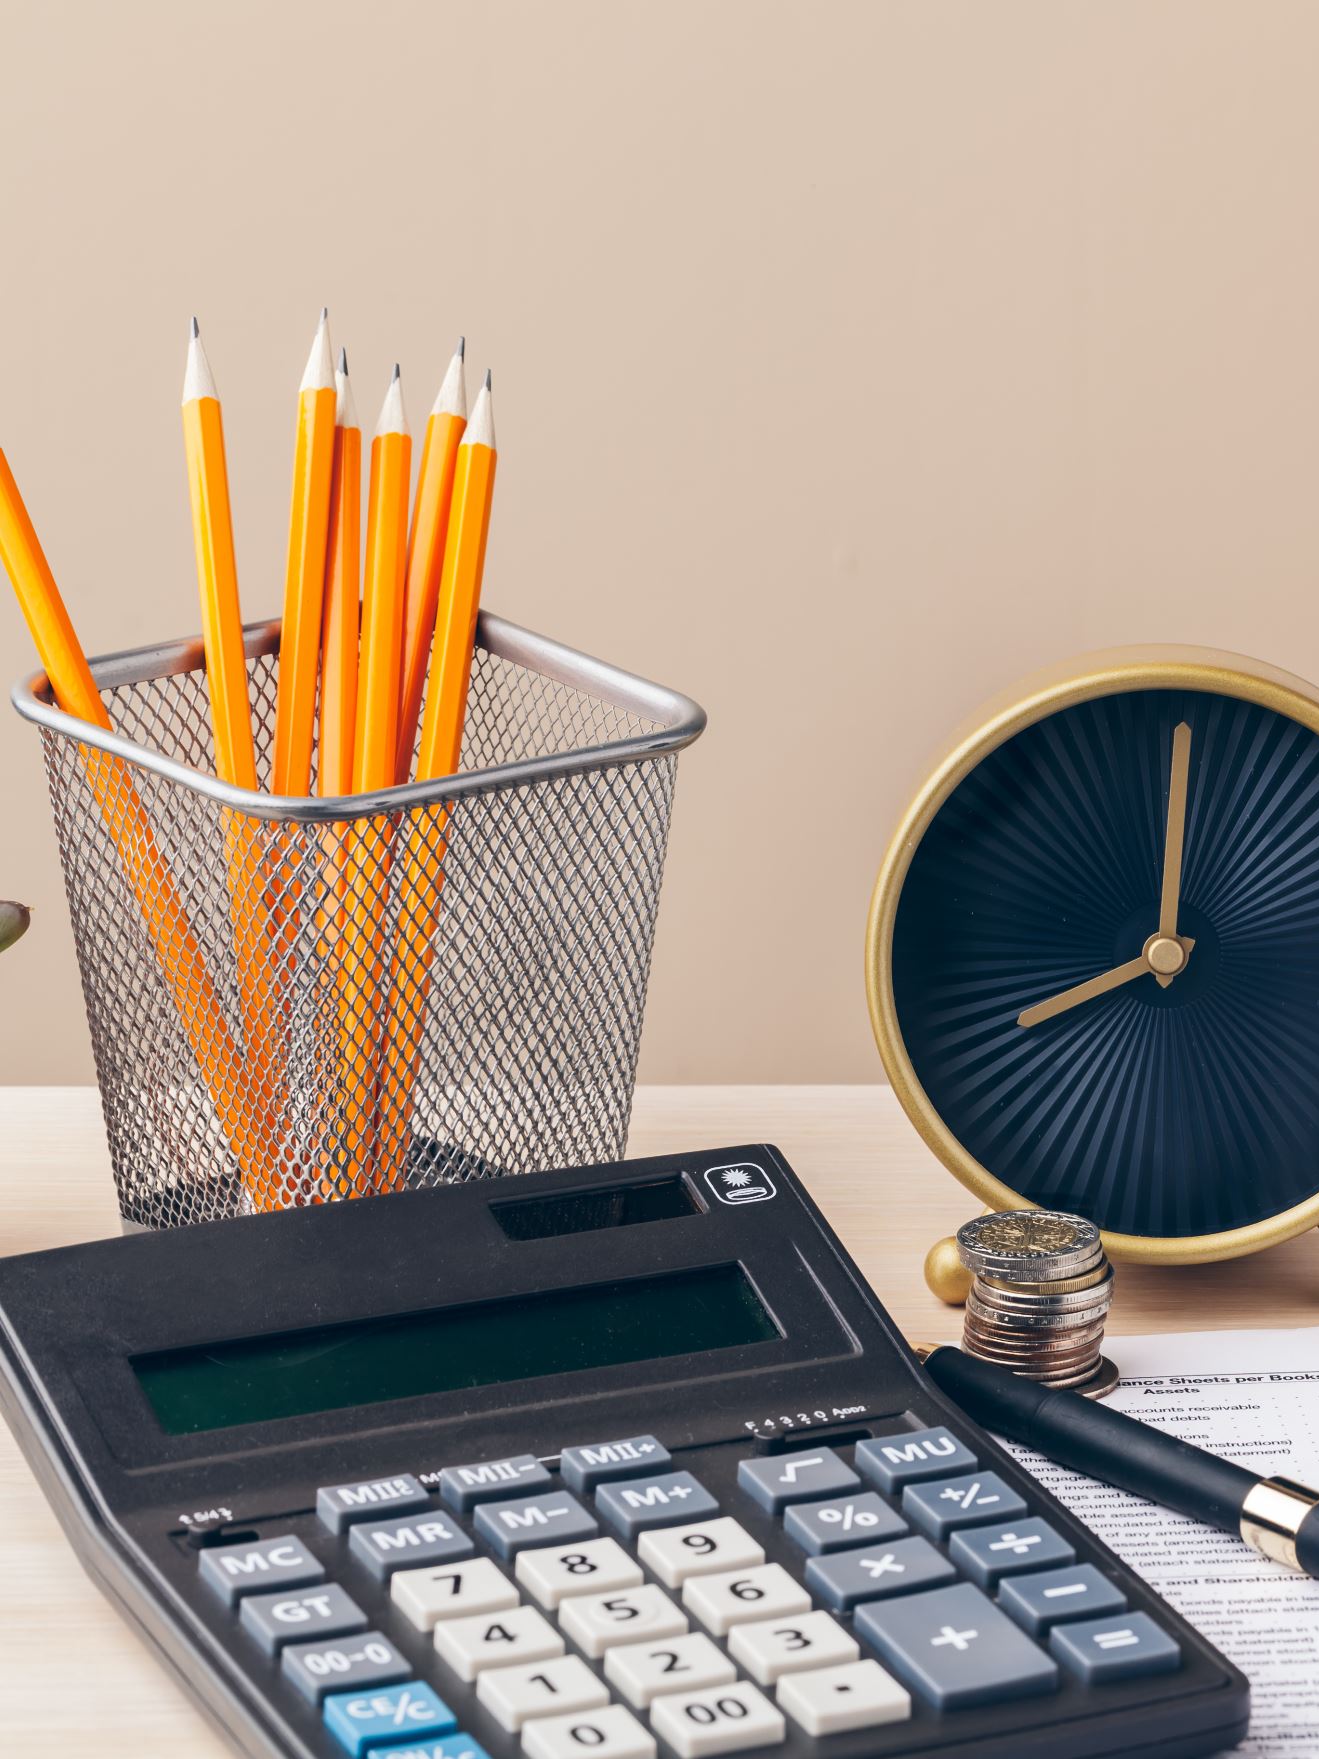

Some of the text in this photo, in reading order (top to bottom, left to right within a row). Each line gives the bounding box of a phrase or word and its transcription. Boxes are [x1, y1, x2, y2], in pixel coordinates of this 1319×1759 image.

[1143, 1386, 1201, 1395] Assets
[1169, 1375, 1231, 1385] Sheets
[1236, 1374, 1265, 1384] per
[1170, 1414, 1211, 1422] debts
[1188, 1403, 1261, 1412] receivable
[880, 1436, 957, 1464] MU
[1205, 1438, 1293, 1449] instructions)
[620, 1485, 693, 1508] M+
[1093, 1492, 1120, 1501] and
[817, 1503, 880, 1532] %
[371, 1521, 454, 1551] MR
[681, 1533, 718, 1556] 9
[219, 1545, 304, 1575] MC
[560, 1553, 598, 1575] 8
[432, 1573, 463, 1596] 7
[729, 1579, 766, 1601] 6
[271, 1594, 331, 1622] GT
[602, 1598, 640, 1622] 5
[483, 1624, 518, 1643] 4
[774, 1628, 812, 1651] 3
[649, 1651, 692, 1673] 2
[529, 1673, 558, 1694] 1
[345, 1691, 437, 1726] CE/C
[684, 1697, 749, 1726] 00
[569, 1723, 606, 1746] 0
